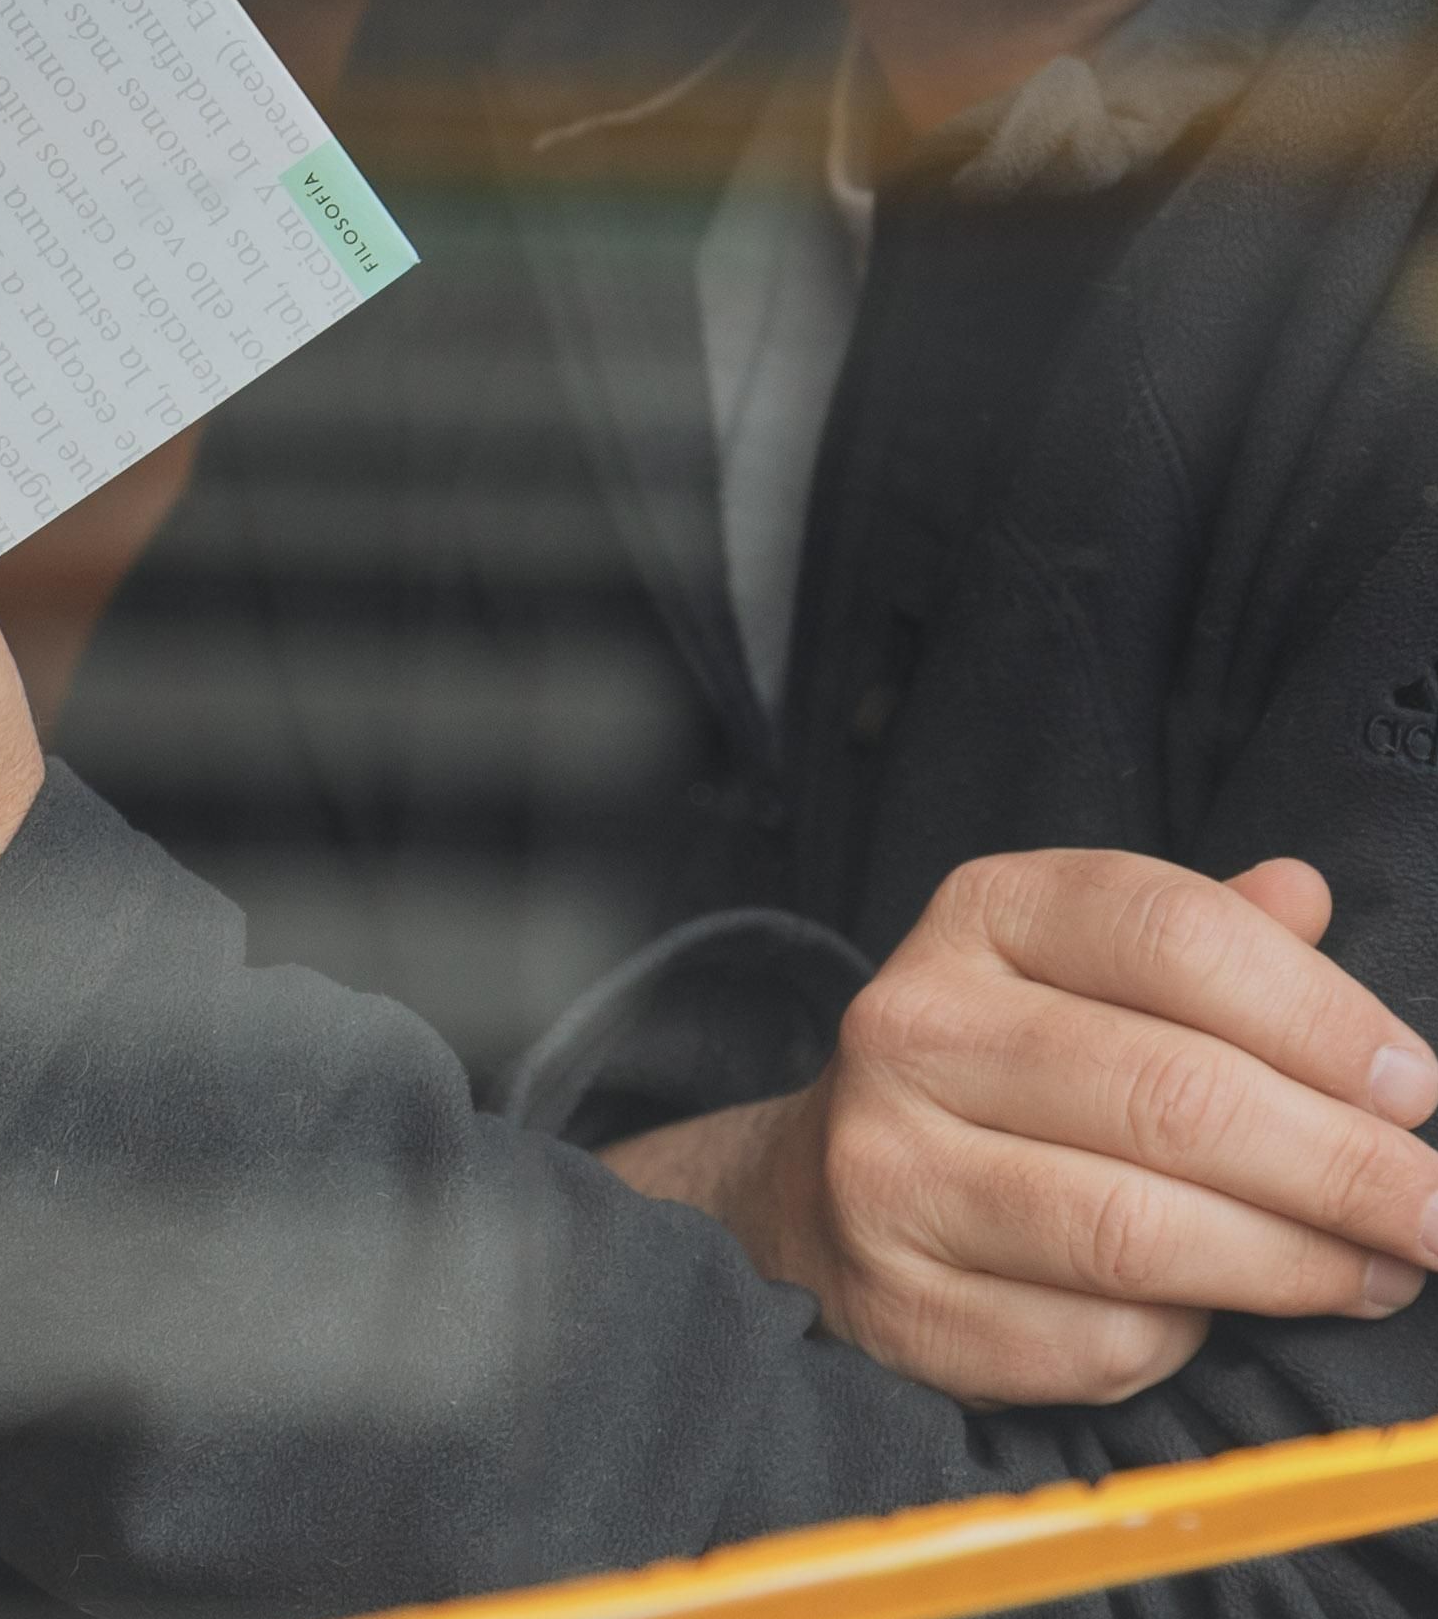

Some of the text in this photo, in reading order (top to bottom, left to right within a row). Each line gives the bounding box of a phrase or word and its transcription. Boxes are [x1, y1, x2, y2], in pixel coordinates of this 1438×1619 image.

[63, 2, 124, 75] más
[82, 118, 128, 175] las
[116, 77, 230, 227] tensiones
[227, 137, 261, 180] la
[35, 142, 116, 244] ciertos
[120, 173, 186, 258] velar
[253, 183, 283, 205] y
[304, 172, 379, 273] FILOSOFÍA
[0, 269, 25, 295] a
[3, 184, 122, 342] estructura
[112, 246, 137, 271] a
[226, 228, 270, 285] las
[185, 261, 234, 320] ello
[19, 302, 117, 424] escapar
[119, 344, 153, 388] la
[30, 401, 64, 441] la
